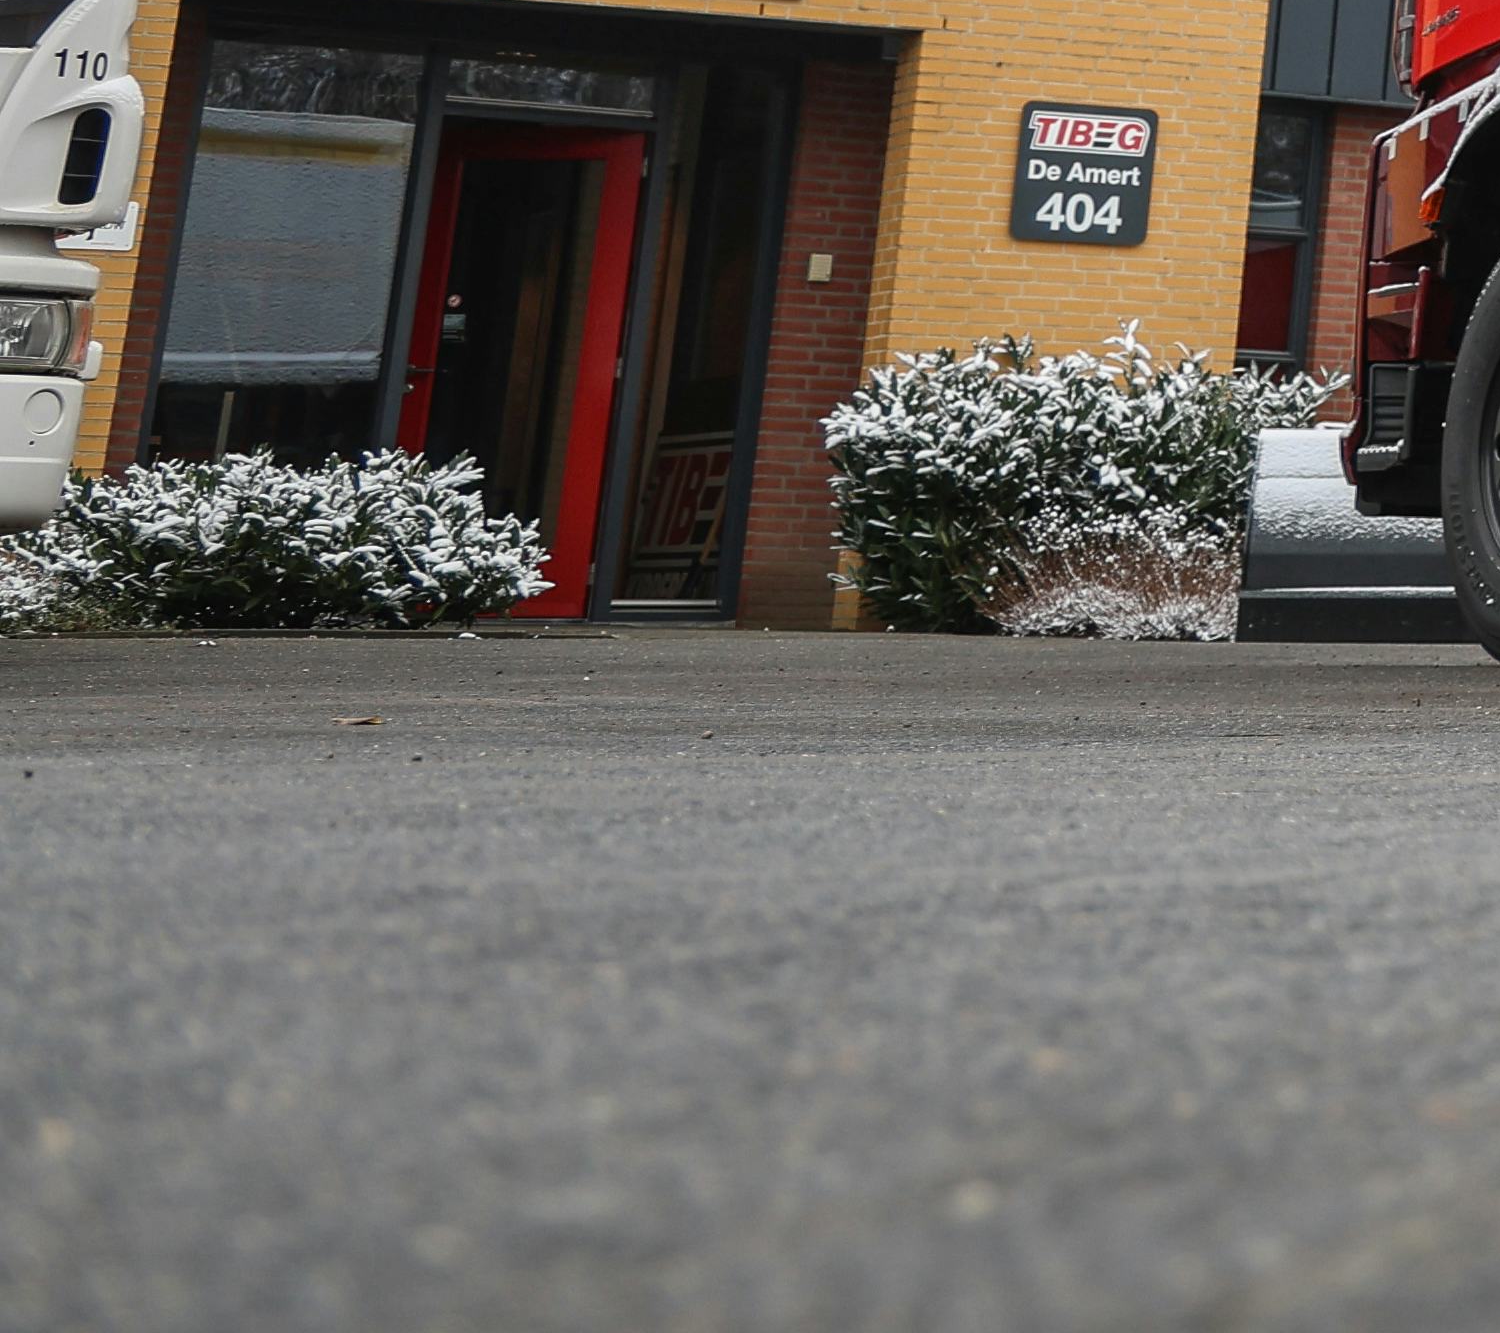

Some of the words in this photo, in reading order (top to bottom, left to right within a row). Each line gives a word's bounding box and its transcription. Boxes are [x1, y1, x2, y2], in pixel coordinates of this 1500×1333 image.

[54, 47, 109, 82] 110
[1036, 116, 1145, 152] TIBEG
[1027, 158, 1062, 181] De
[1066, 161, 1142, 187] Amert
[1034, 191, 1123, 235] 404
